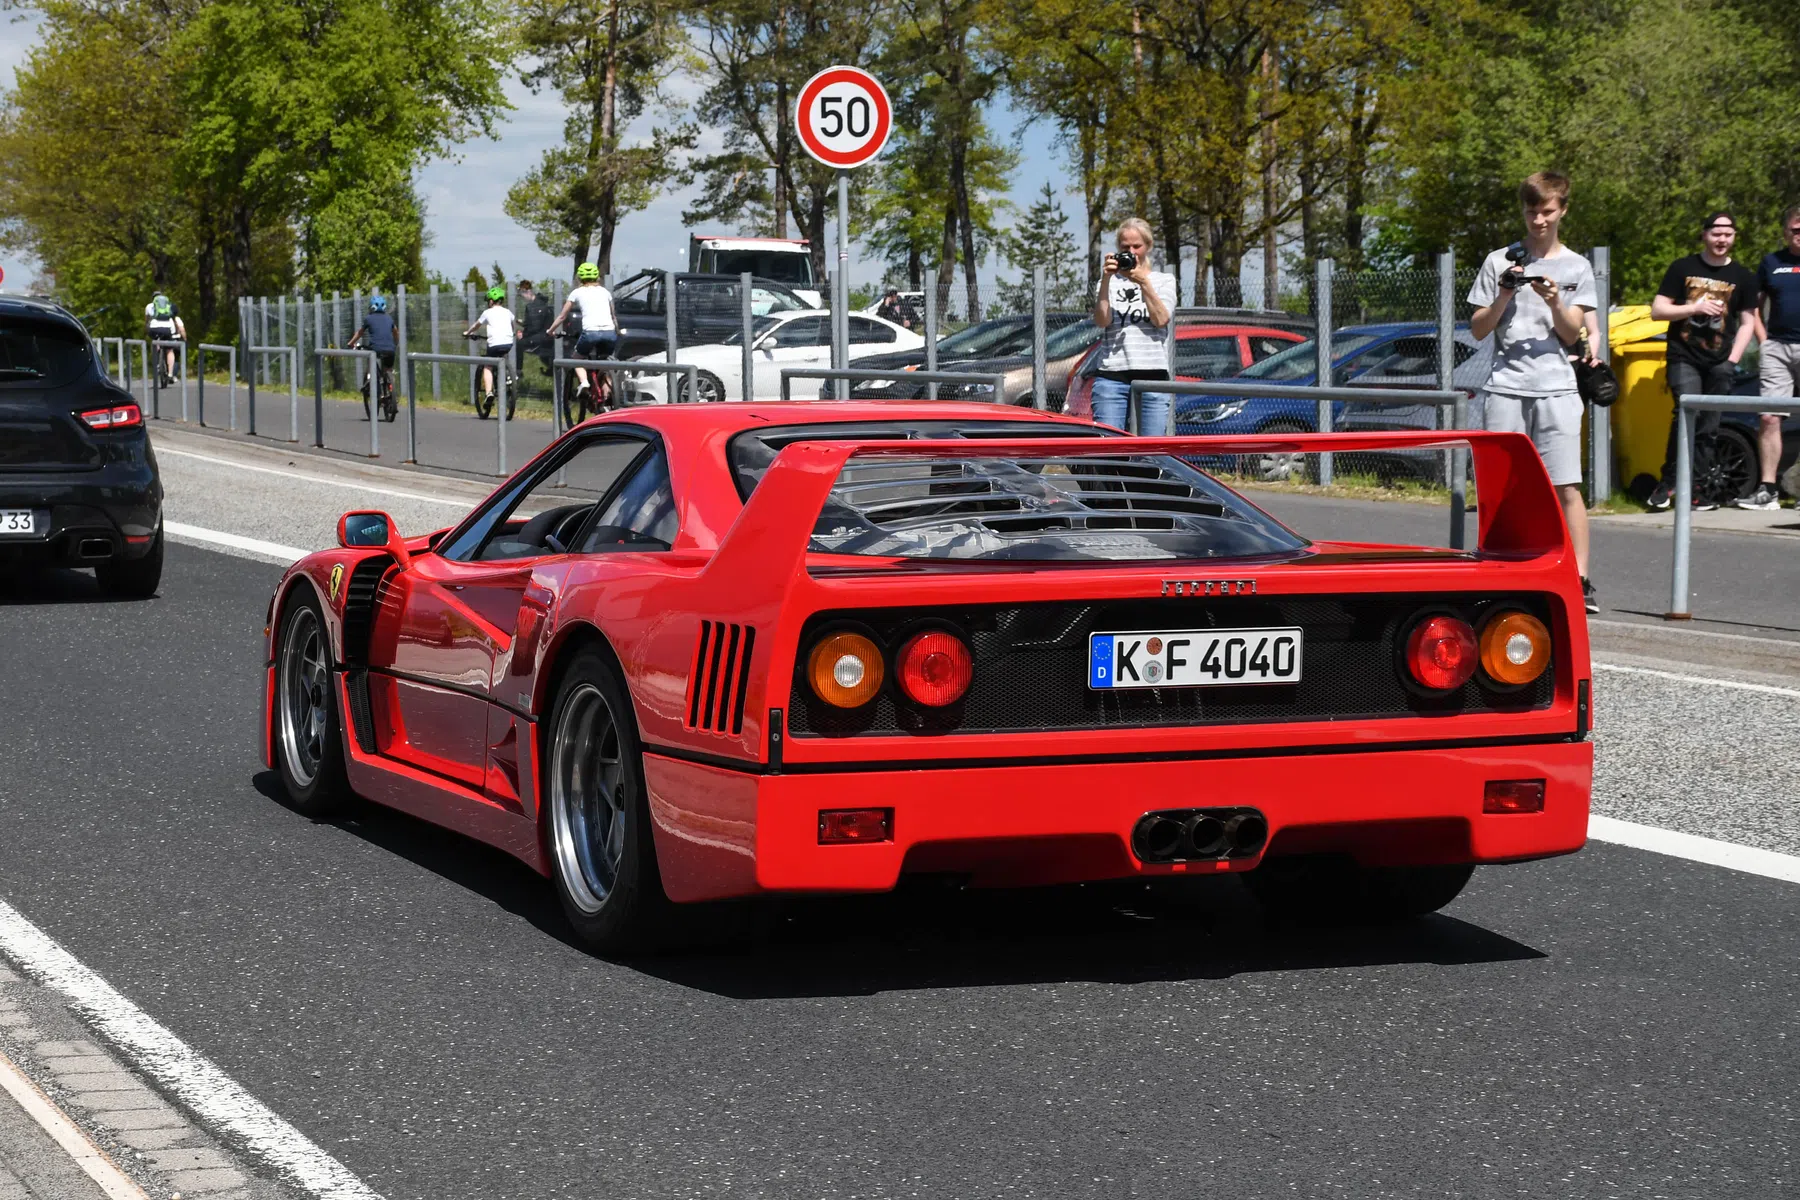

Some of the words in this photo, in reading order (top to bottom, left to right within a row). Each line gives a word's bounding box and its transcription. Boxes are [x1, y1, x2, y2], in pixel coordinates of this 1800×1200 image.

[820, 96, 870, 138] 50
[1161, 578, 1257, 594] Ferrari
[1097, 666, 1107, 679] D
[1117, 640, 1141, 681] K
[1166, 639, 1191, 680] F
[1200, 636, 1295, 679] 4040
